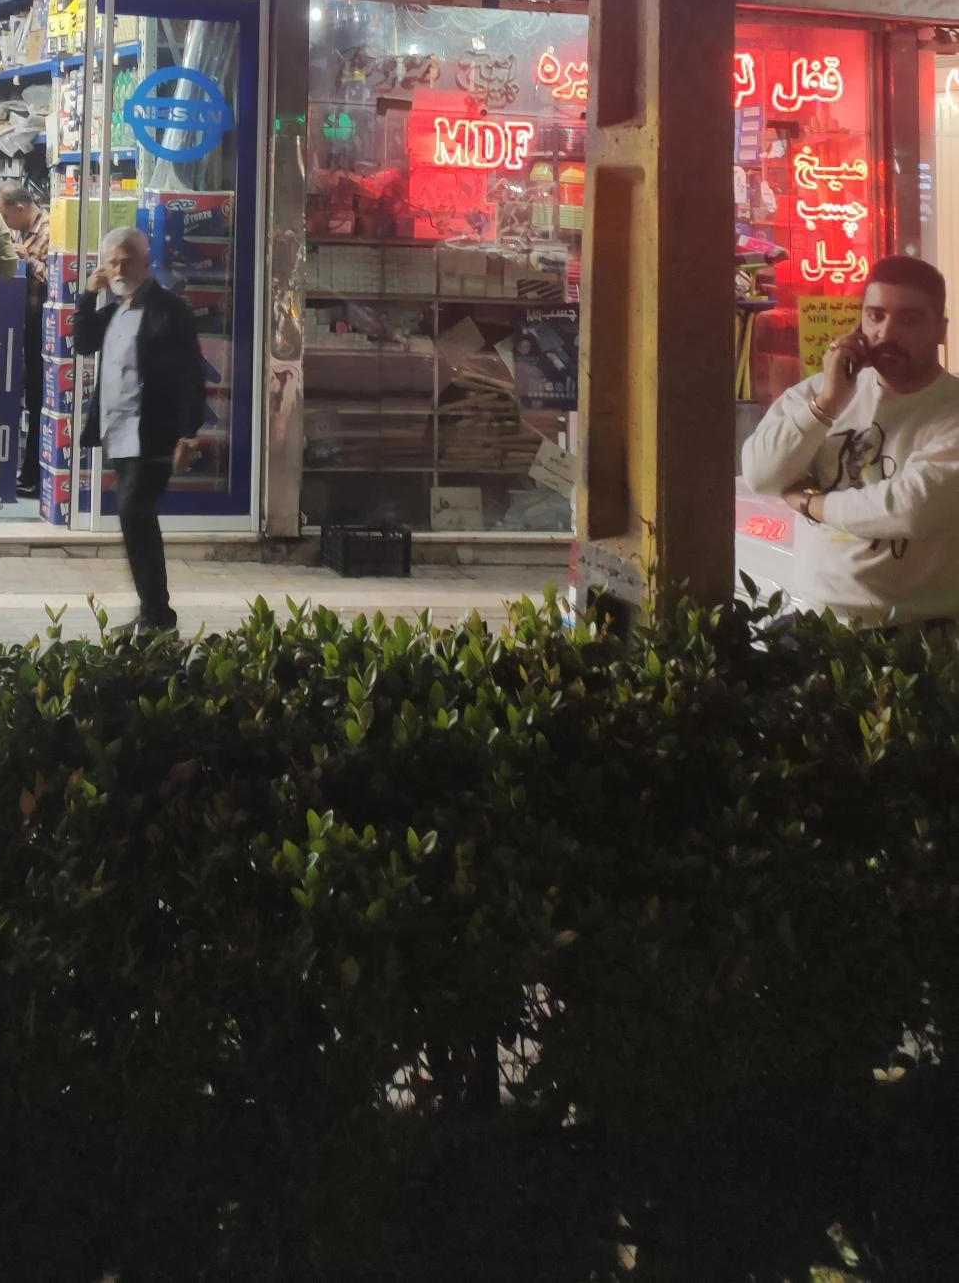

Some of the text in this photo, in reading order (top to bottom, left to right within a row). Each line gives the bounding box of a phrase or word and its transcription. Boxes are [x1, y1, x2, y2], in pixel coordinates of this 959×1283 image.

[772, 56, 844, 113] قفل
[434, 117, 533, 169] MDF
[801, 240, 869, 283] ریل
